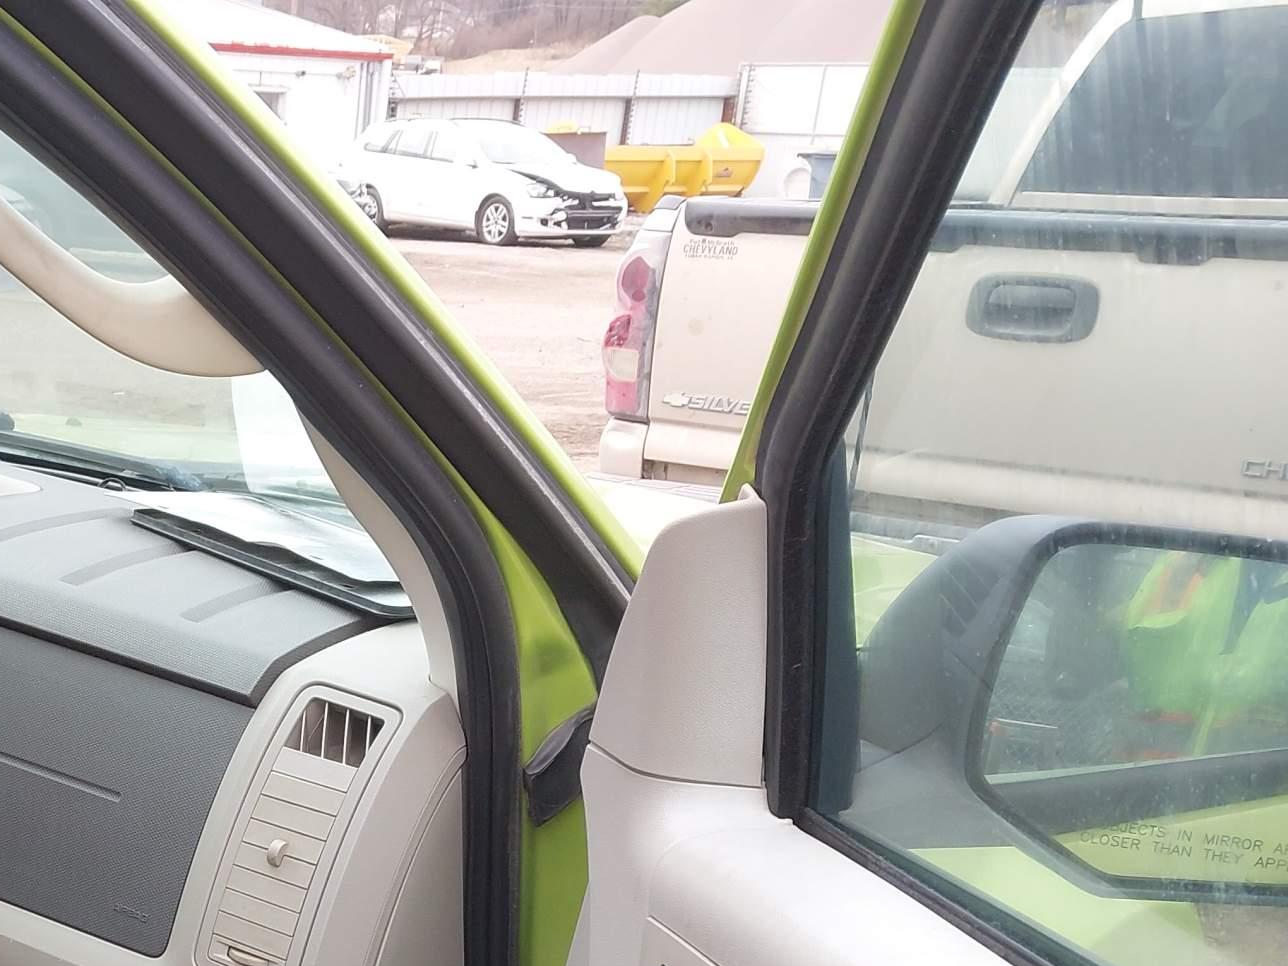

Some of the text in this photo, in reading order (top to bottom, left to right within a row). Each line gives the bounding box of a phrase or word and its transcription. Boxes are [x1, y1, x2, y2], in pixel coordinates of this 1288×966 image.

[683, 244, 738, 257] CHEVYLAND
[1079, 831, 1288, 873] CLOSER THAN THEY APP
[1103, 822, 1167, 839] BJECTS
[1176, 829, 1193, 843] IN
[1203, 832, 1265, 853] MIRROR
